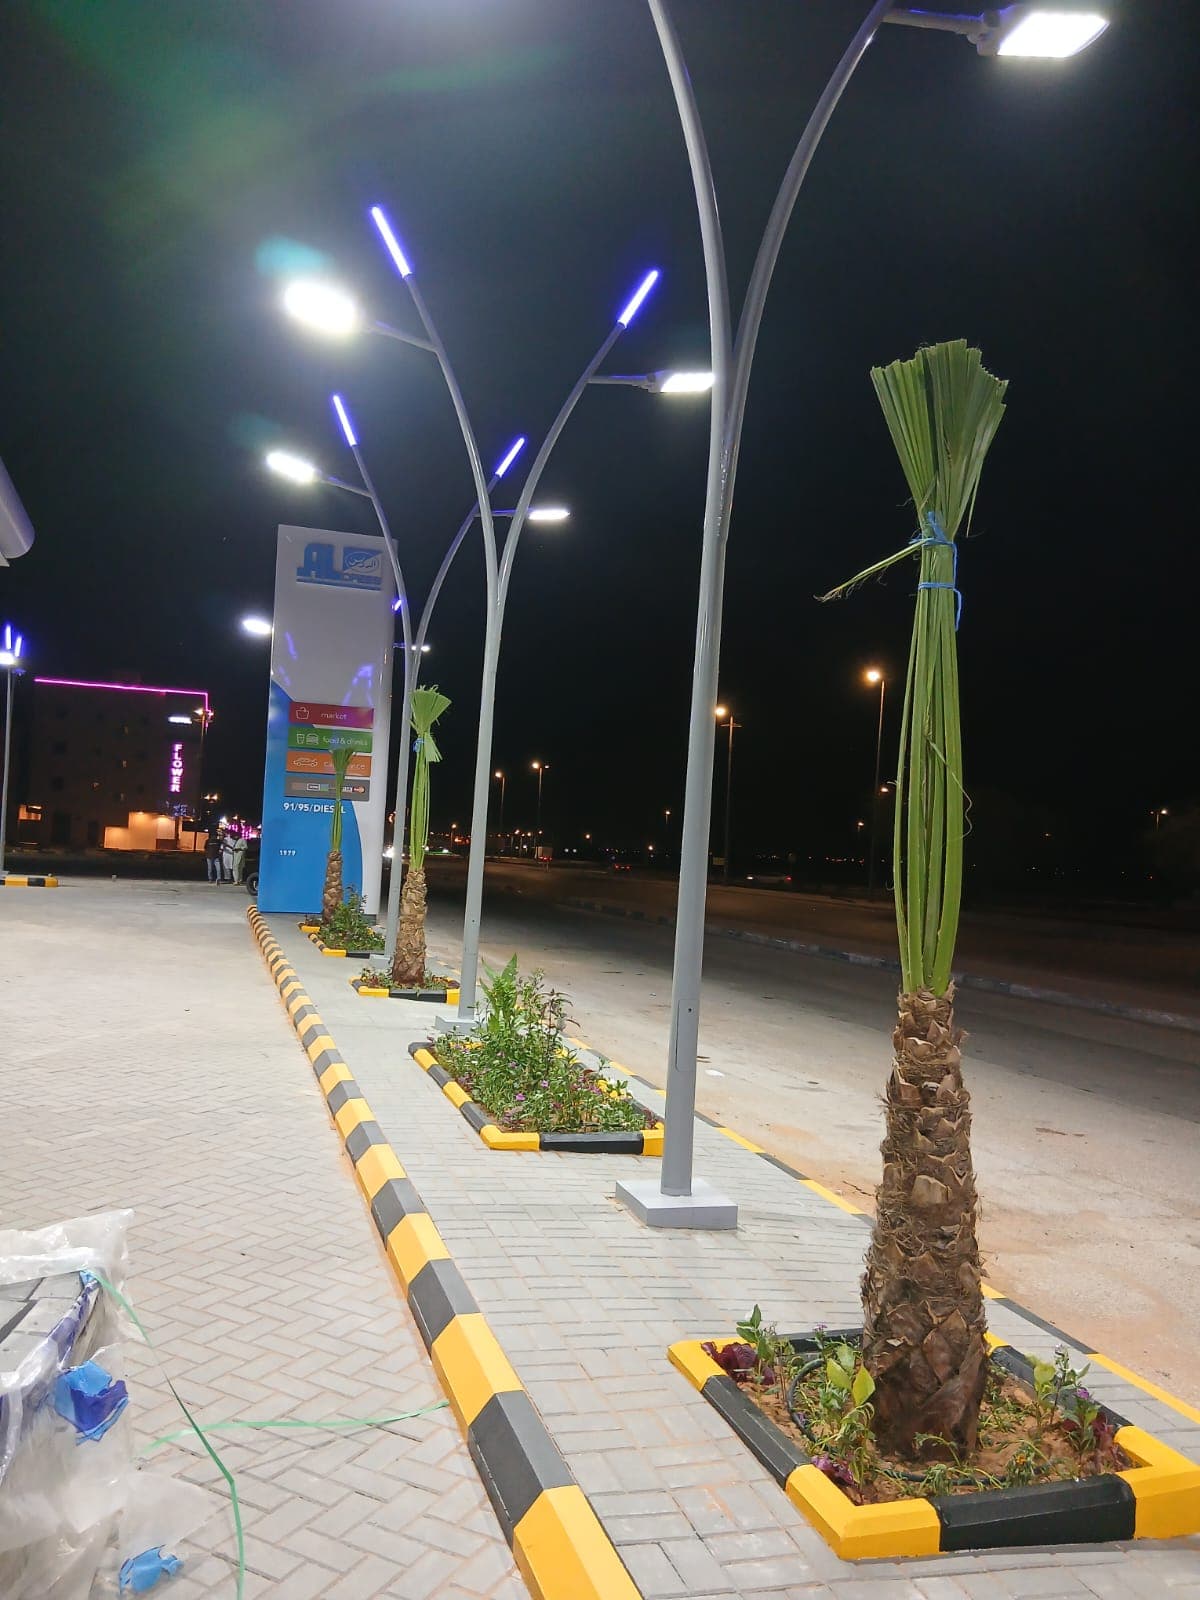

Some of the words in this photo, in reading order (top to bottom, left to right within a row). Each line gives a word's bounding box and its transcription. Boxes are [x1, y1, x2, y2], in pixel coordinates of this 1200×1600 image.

[320, 711, 347, 720] market
[170, 743, 184, 792] FLOWER
[283, 802, 346, 814] 91/95/DIESL
